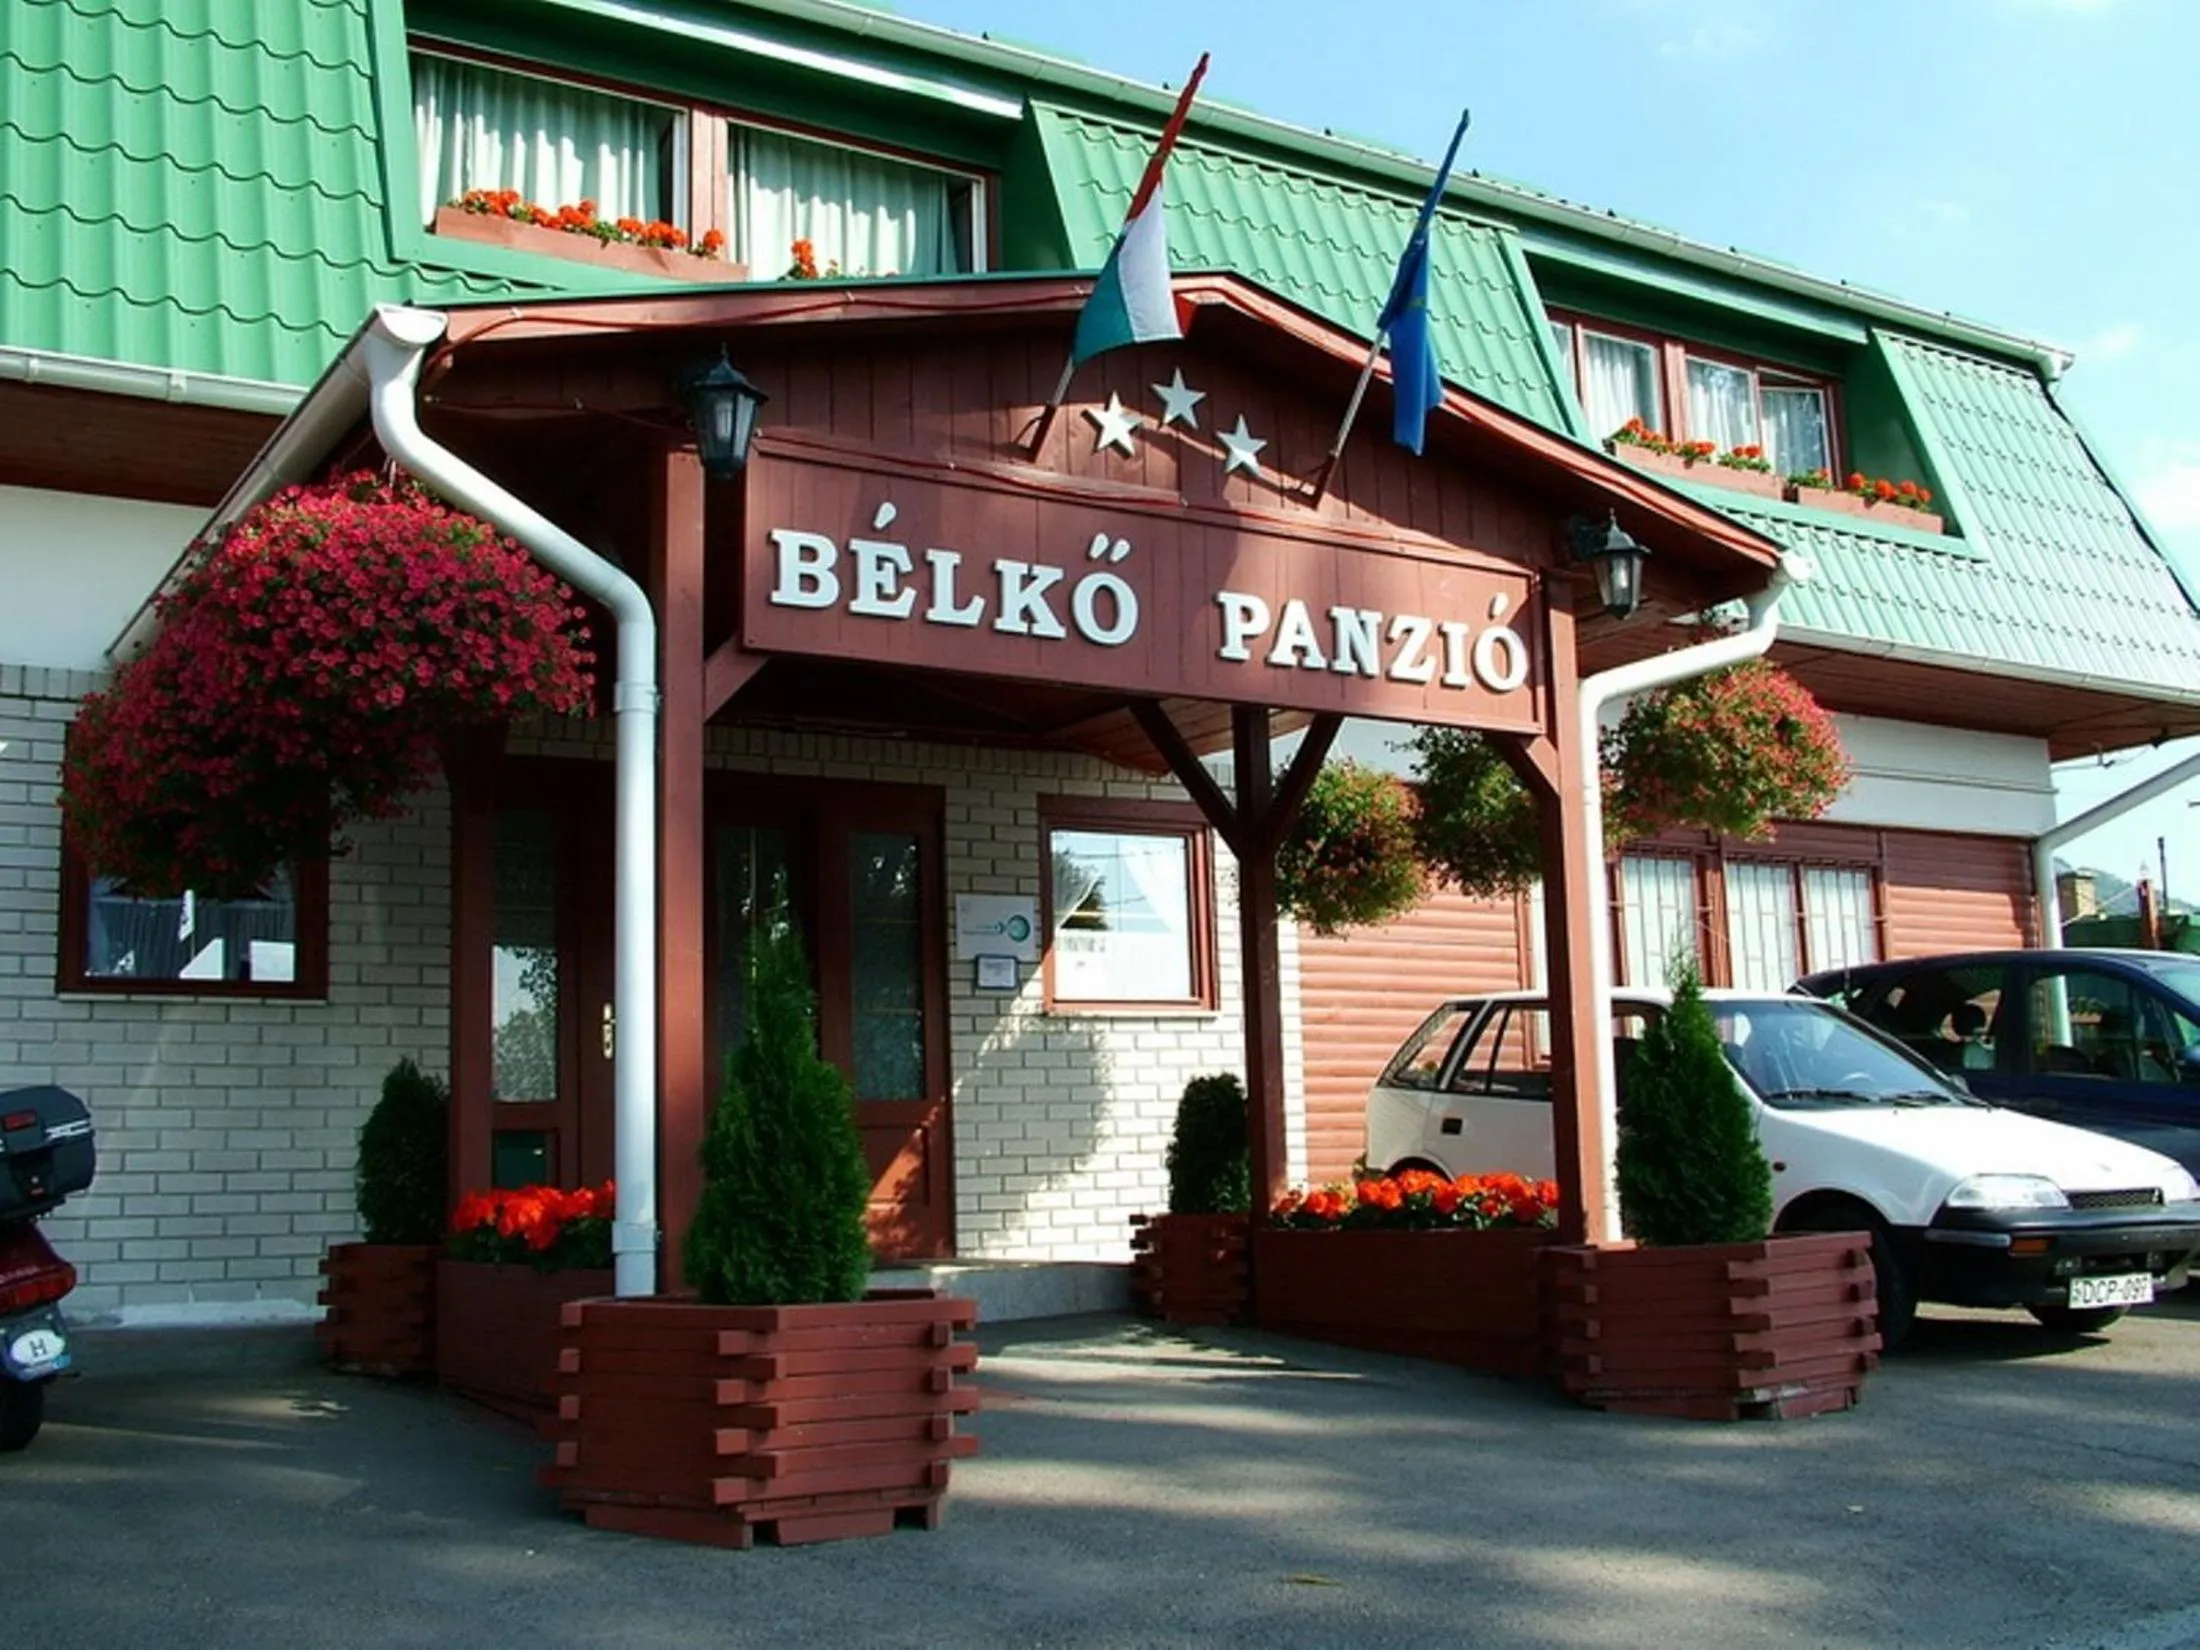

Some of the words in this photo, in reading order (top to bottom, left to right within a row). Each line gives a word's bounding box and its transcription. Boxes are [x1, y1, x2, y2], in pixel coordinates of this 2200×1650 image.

[770, 502, 1139, 645] BÉLKŐ
[1216, 591, 1529, 692] PANZIÓ
[28, 1338, 47, 1358] H
